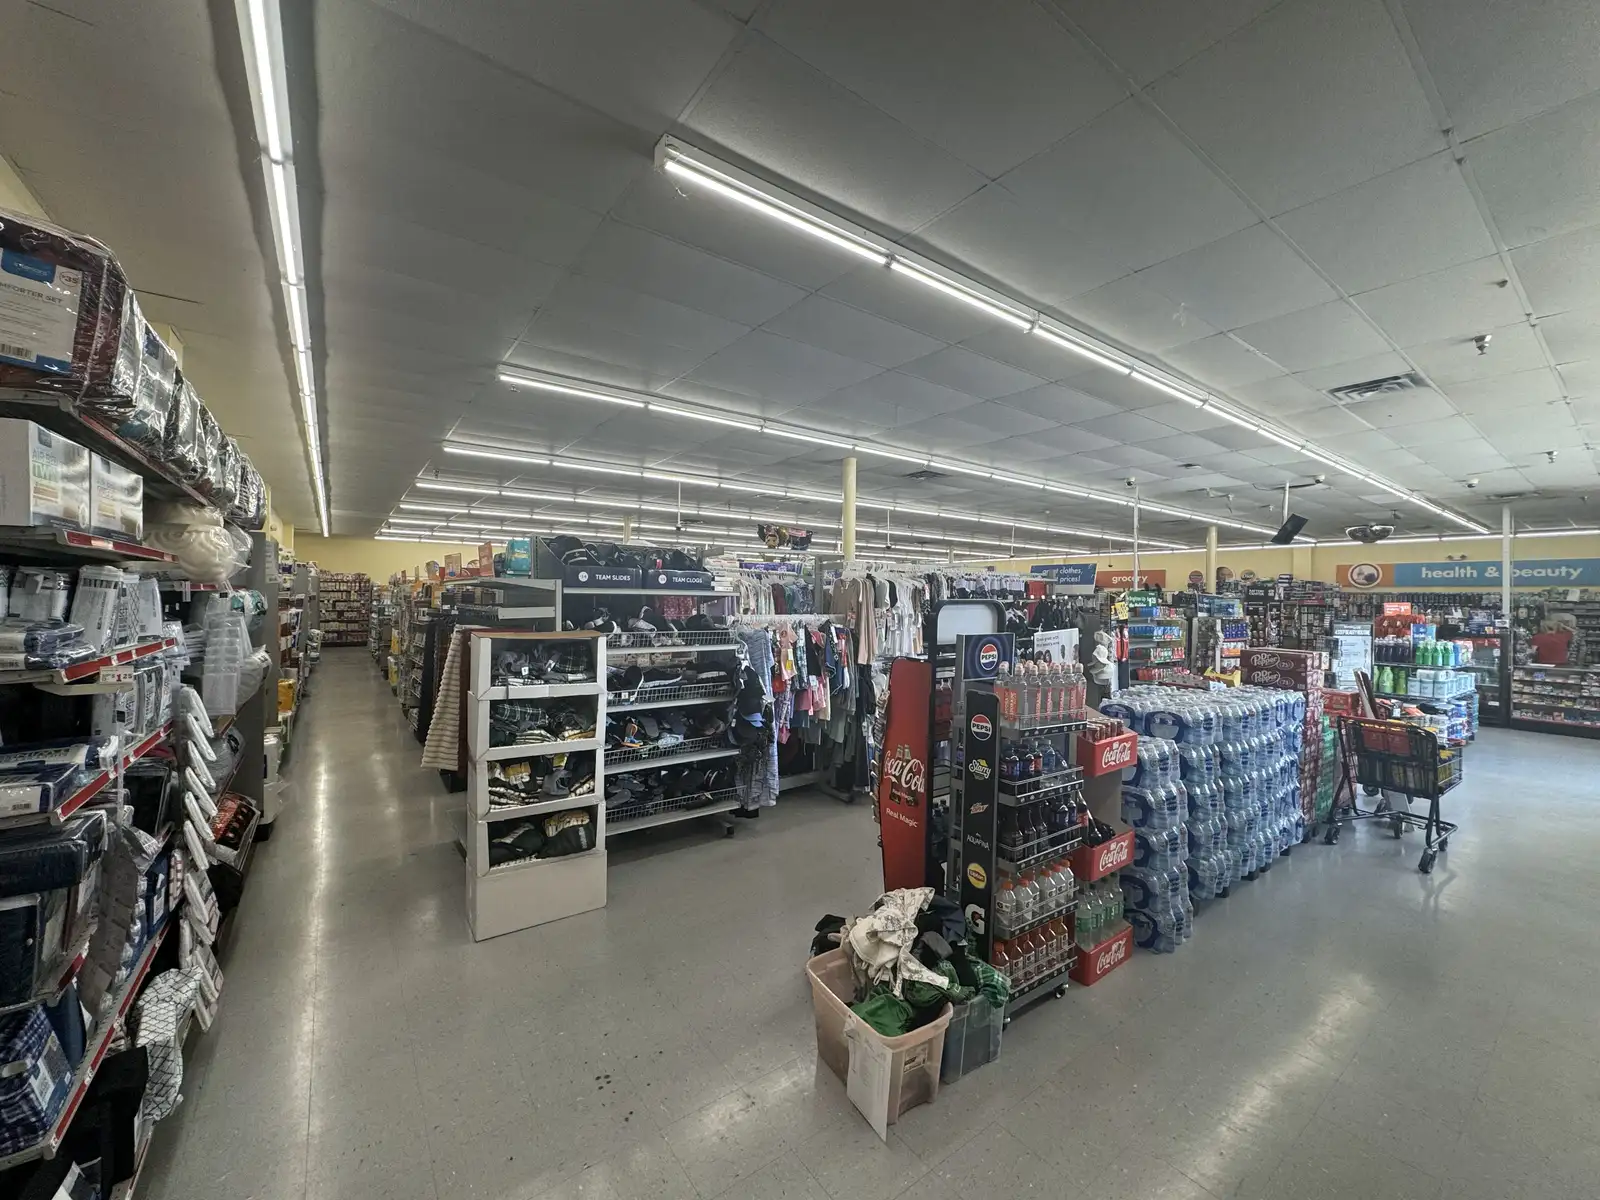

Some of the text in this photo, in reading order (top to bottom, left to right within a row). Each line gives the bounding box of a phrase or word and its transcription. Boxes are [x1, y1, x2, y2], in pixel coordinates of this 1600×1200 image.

[612, 574, 631, 582] SLIDES
[1421, 567, 1477, 579] health
[1484, 566, 1501, 578] &
[672, 576, 685, 584] TEAM
[981, 653, 997, 661] PEPSI
[1253, 654, 1278, 666] Pepper
[1254, 671, 1279, 683] Pepper
[972, 722, 991, 733] PEPSI
[1102, 741, 1131, 768] Coca-Cola
[968, 759, 992, 779] Starry
[886, 807, 919, 828] Real Magic
[966, 833, 991, 851] AQUAFINA
[1099, 839, 1128, 871] Coca-Cola
[1096, 938, 1127, 974] Coca-Cola
